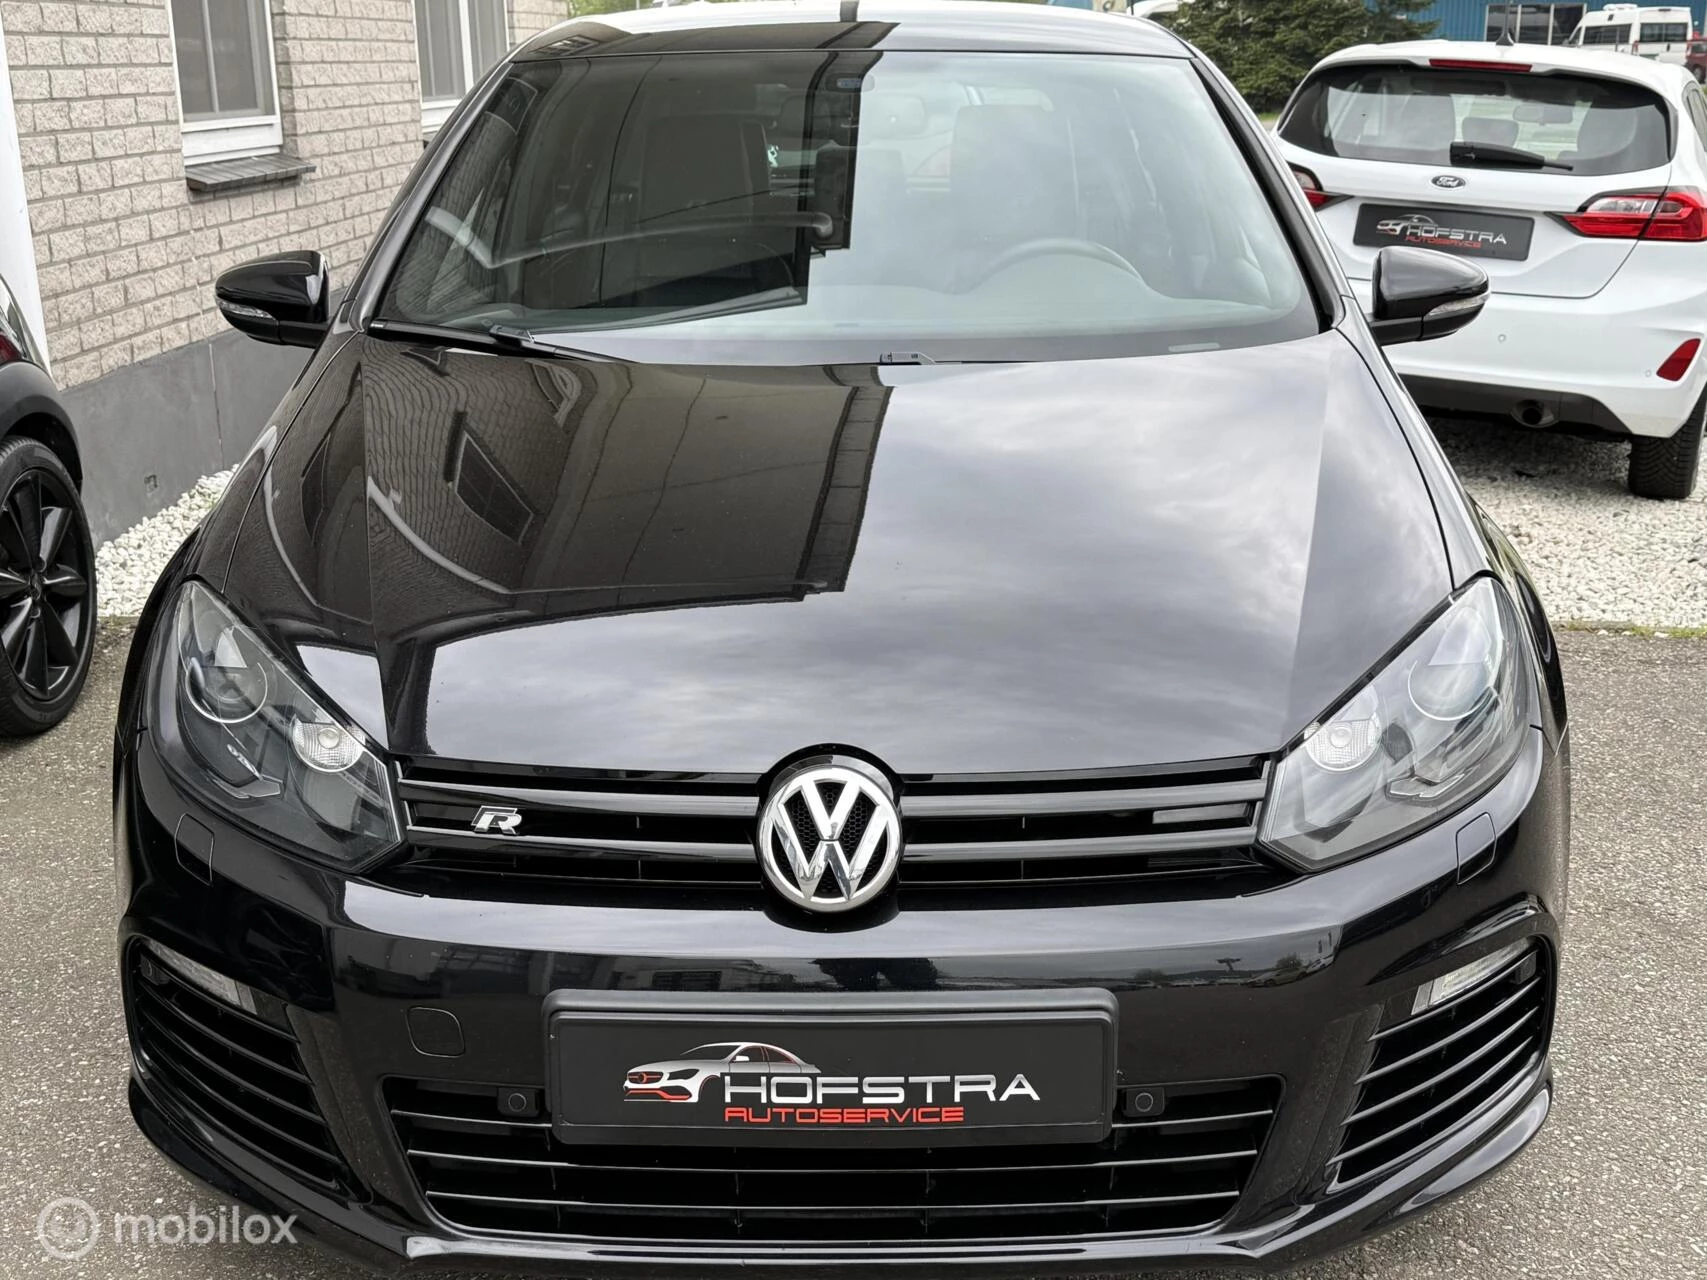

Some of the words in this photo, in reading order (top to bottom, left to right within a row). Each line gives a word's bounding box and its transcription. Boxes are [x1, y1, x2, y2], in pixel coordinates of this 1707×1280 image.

[1436, 175, 1459, 187] Ford
[1405, 236, 1482, 248] AUTOSERVICE
[1406, 224, 1507, 245] HOFSTRA
[471, 805, 522, 835] R
[762, 771, 898, 907] VW
[724, 1073, 1041, 1104] HOFSTRA
[724, 1106, 964, 1124] AUTOSERVICE
